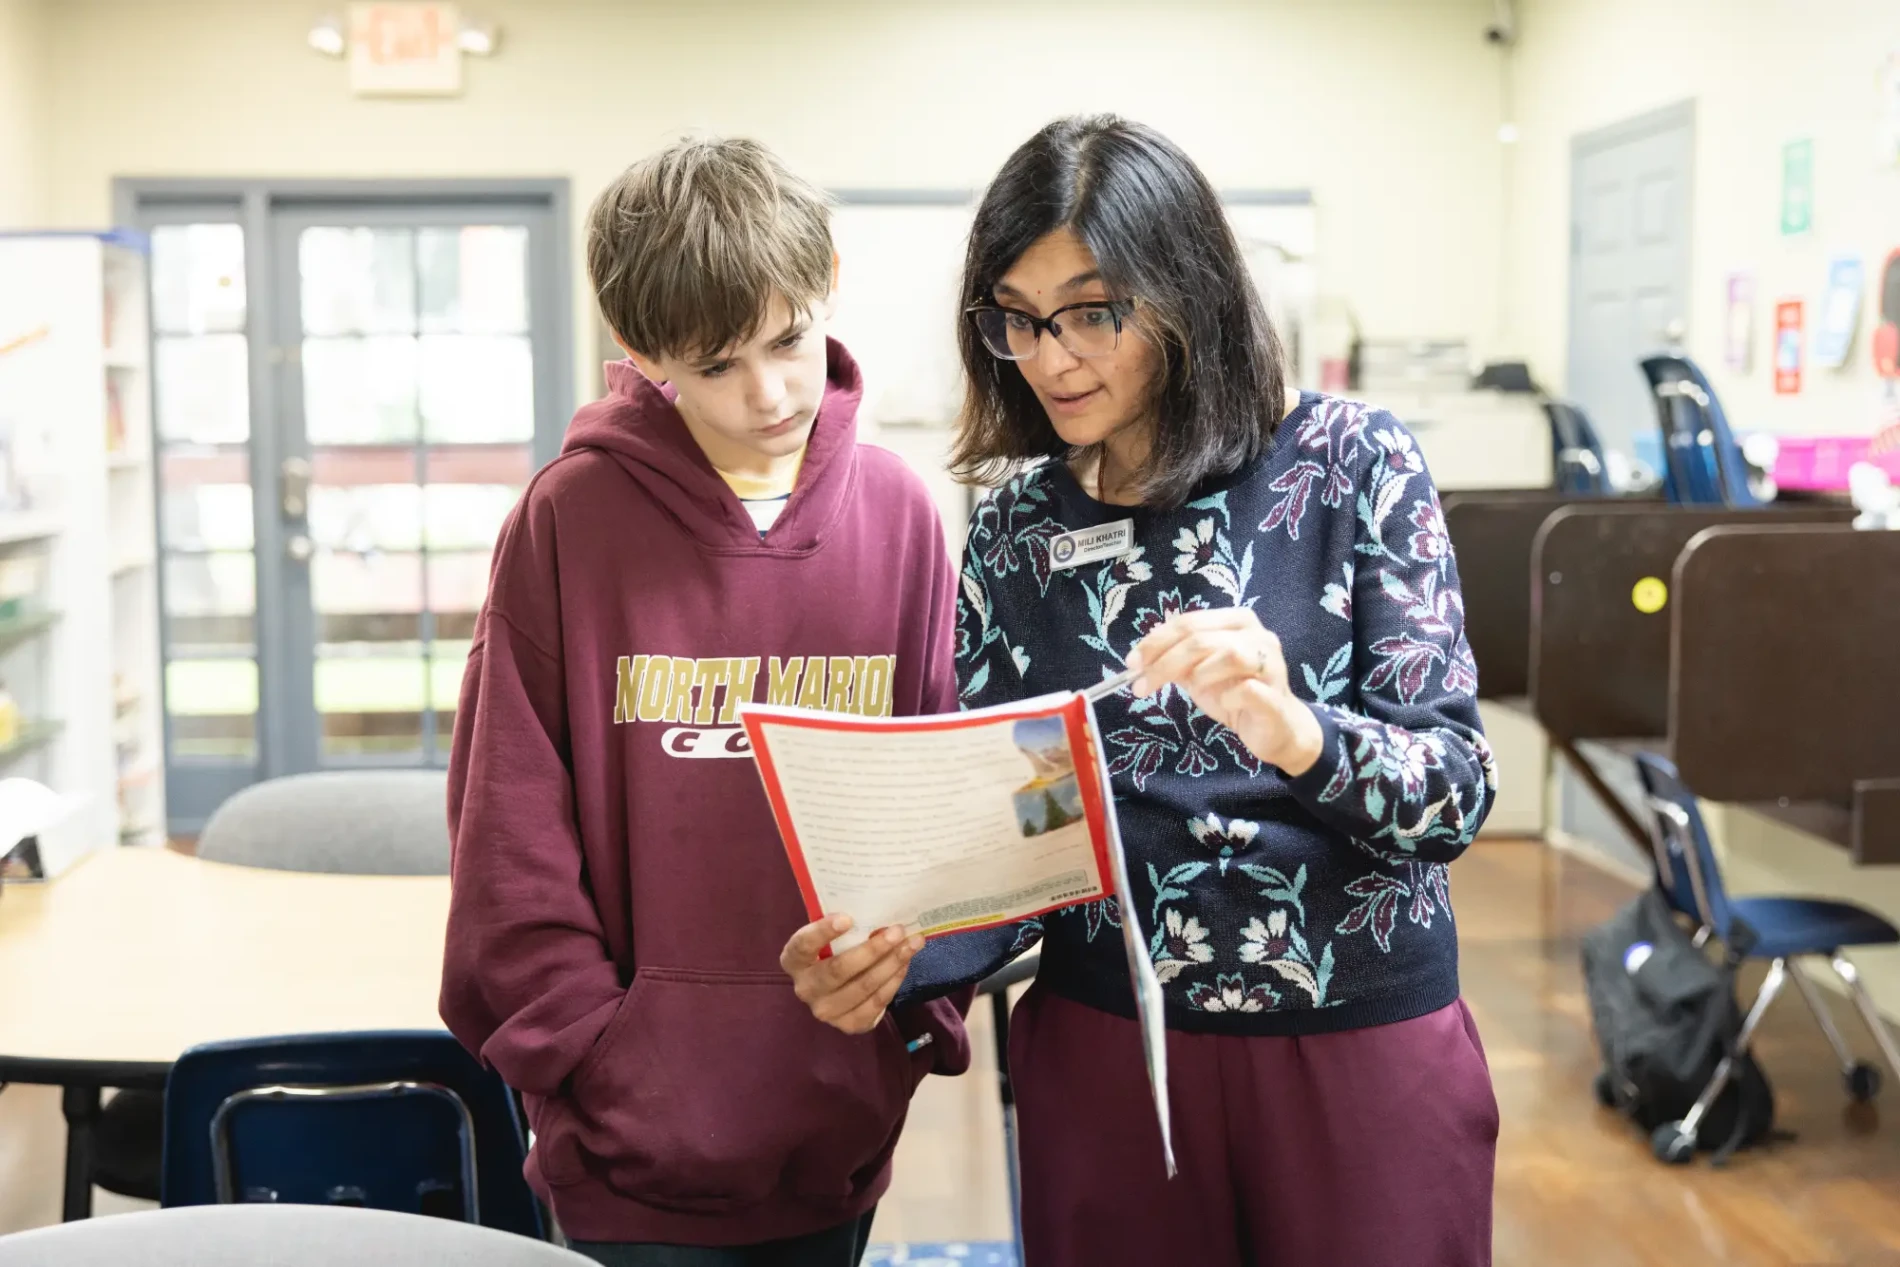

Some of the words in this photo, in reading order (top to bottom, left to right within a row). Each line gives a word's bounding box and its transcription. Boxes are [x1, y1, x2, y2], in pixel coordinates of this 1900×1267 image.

[1077, 537, 1094, 548] MILI
[1096, 529, 1126, 543] KHATRI
[614, 654, 761, 724] NORTH
